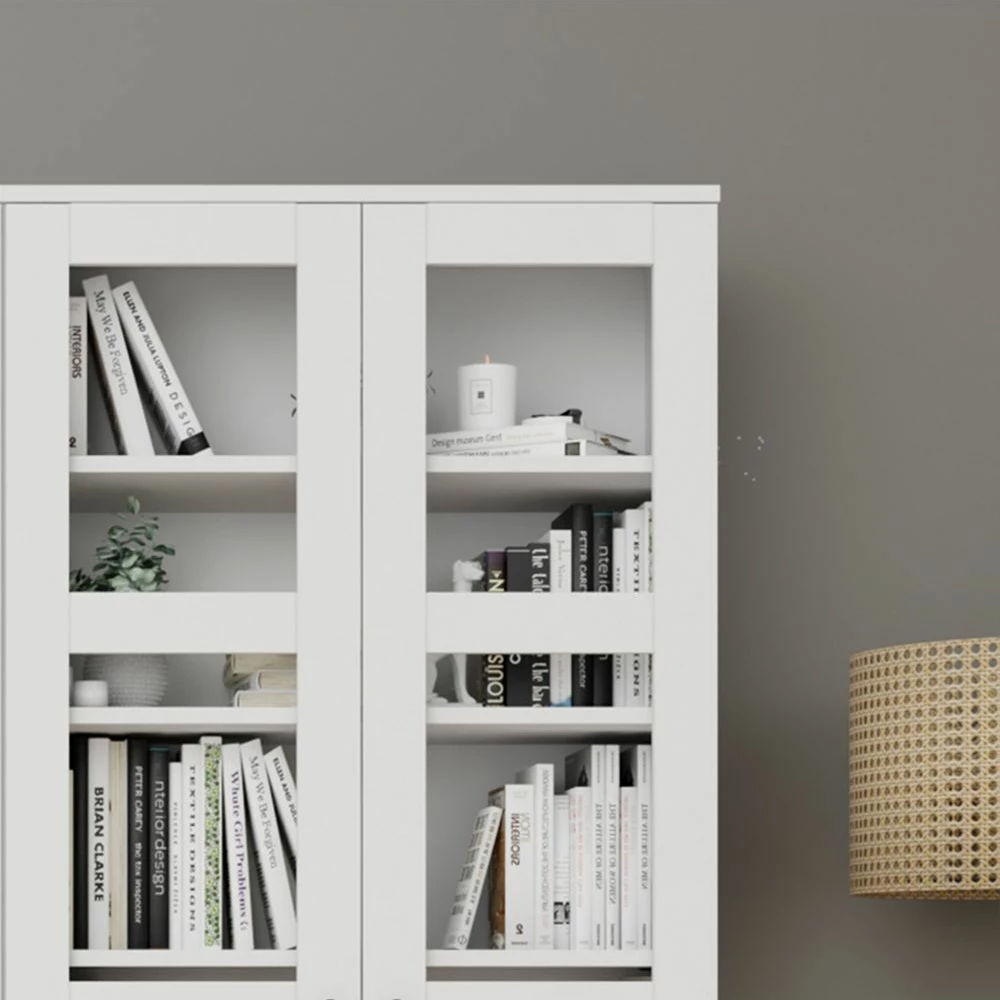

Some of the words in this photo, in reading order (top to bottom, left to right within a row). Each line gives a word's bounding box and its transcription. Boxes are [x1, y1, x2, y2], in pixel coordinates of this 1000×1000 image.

[101, 315, 113, 333] We
[134, 314, 146, 332] AND
[72, 325, 81, 378] INTERIORS
[106, 333, 117, 348] Be
[110, 350, 128, 396] Forgiven
[69, 437, 76, 447] 2
[255, 783, 265, 803] We
[94, 787, 104, 837] BRIAN
[233, 821, 244, 850] Girl
[94, 843, 104, 901] CLARKE
[235, 852, 248, 920] Problems
